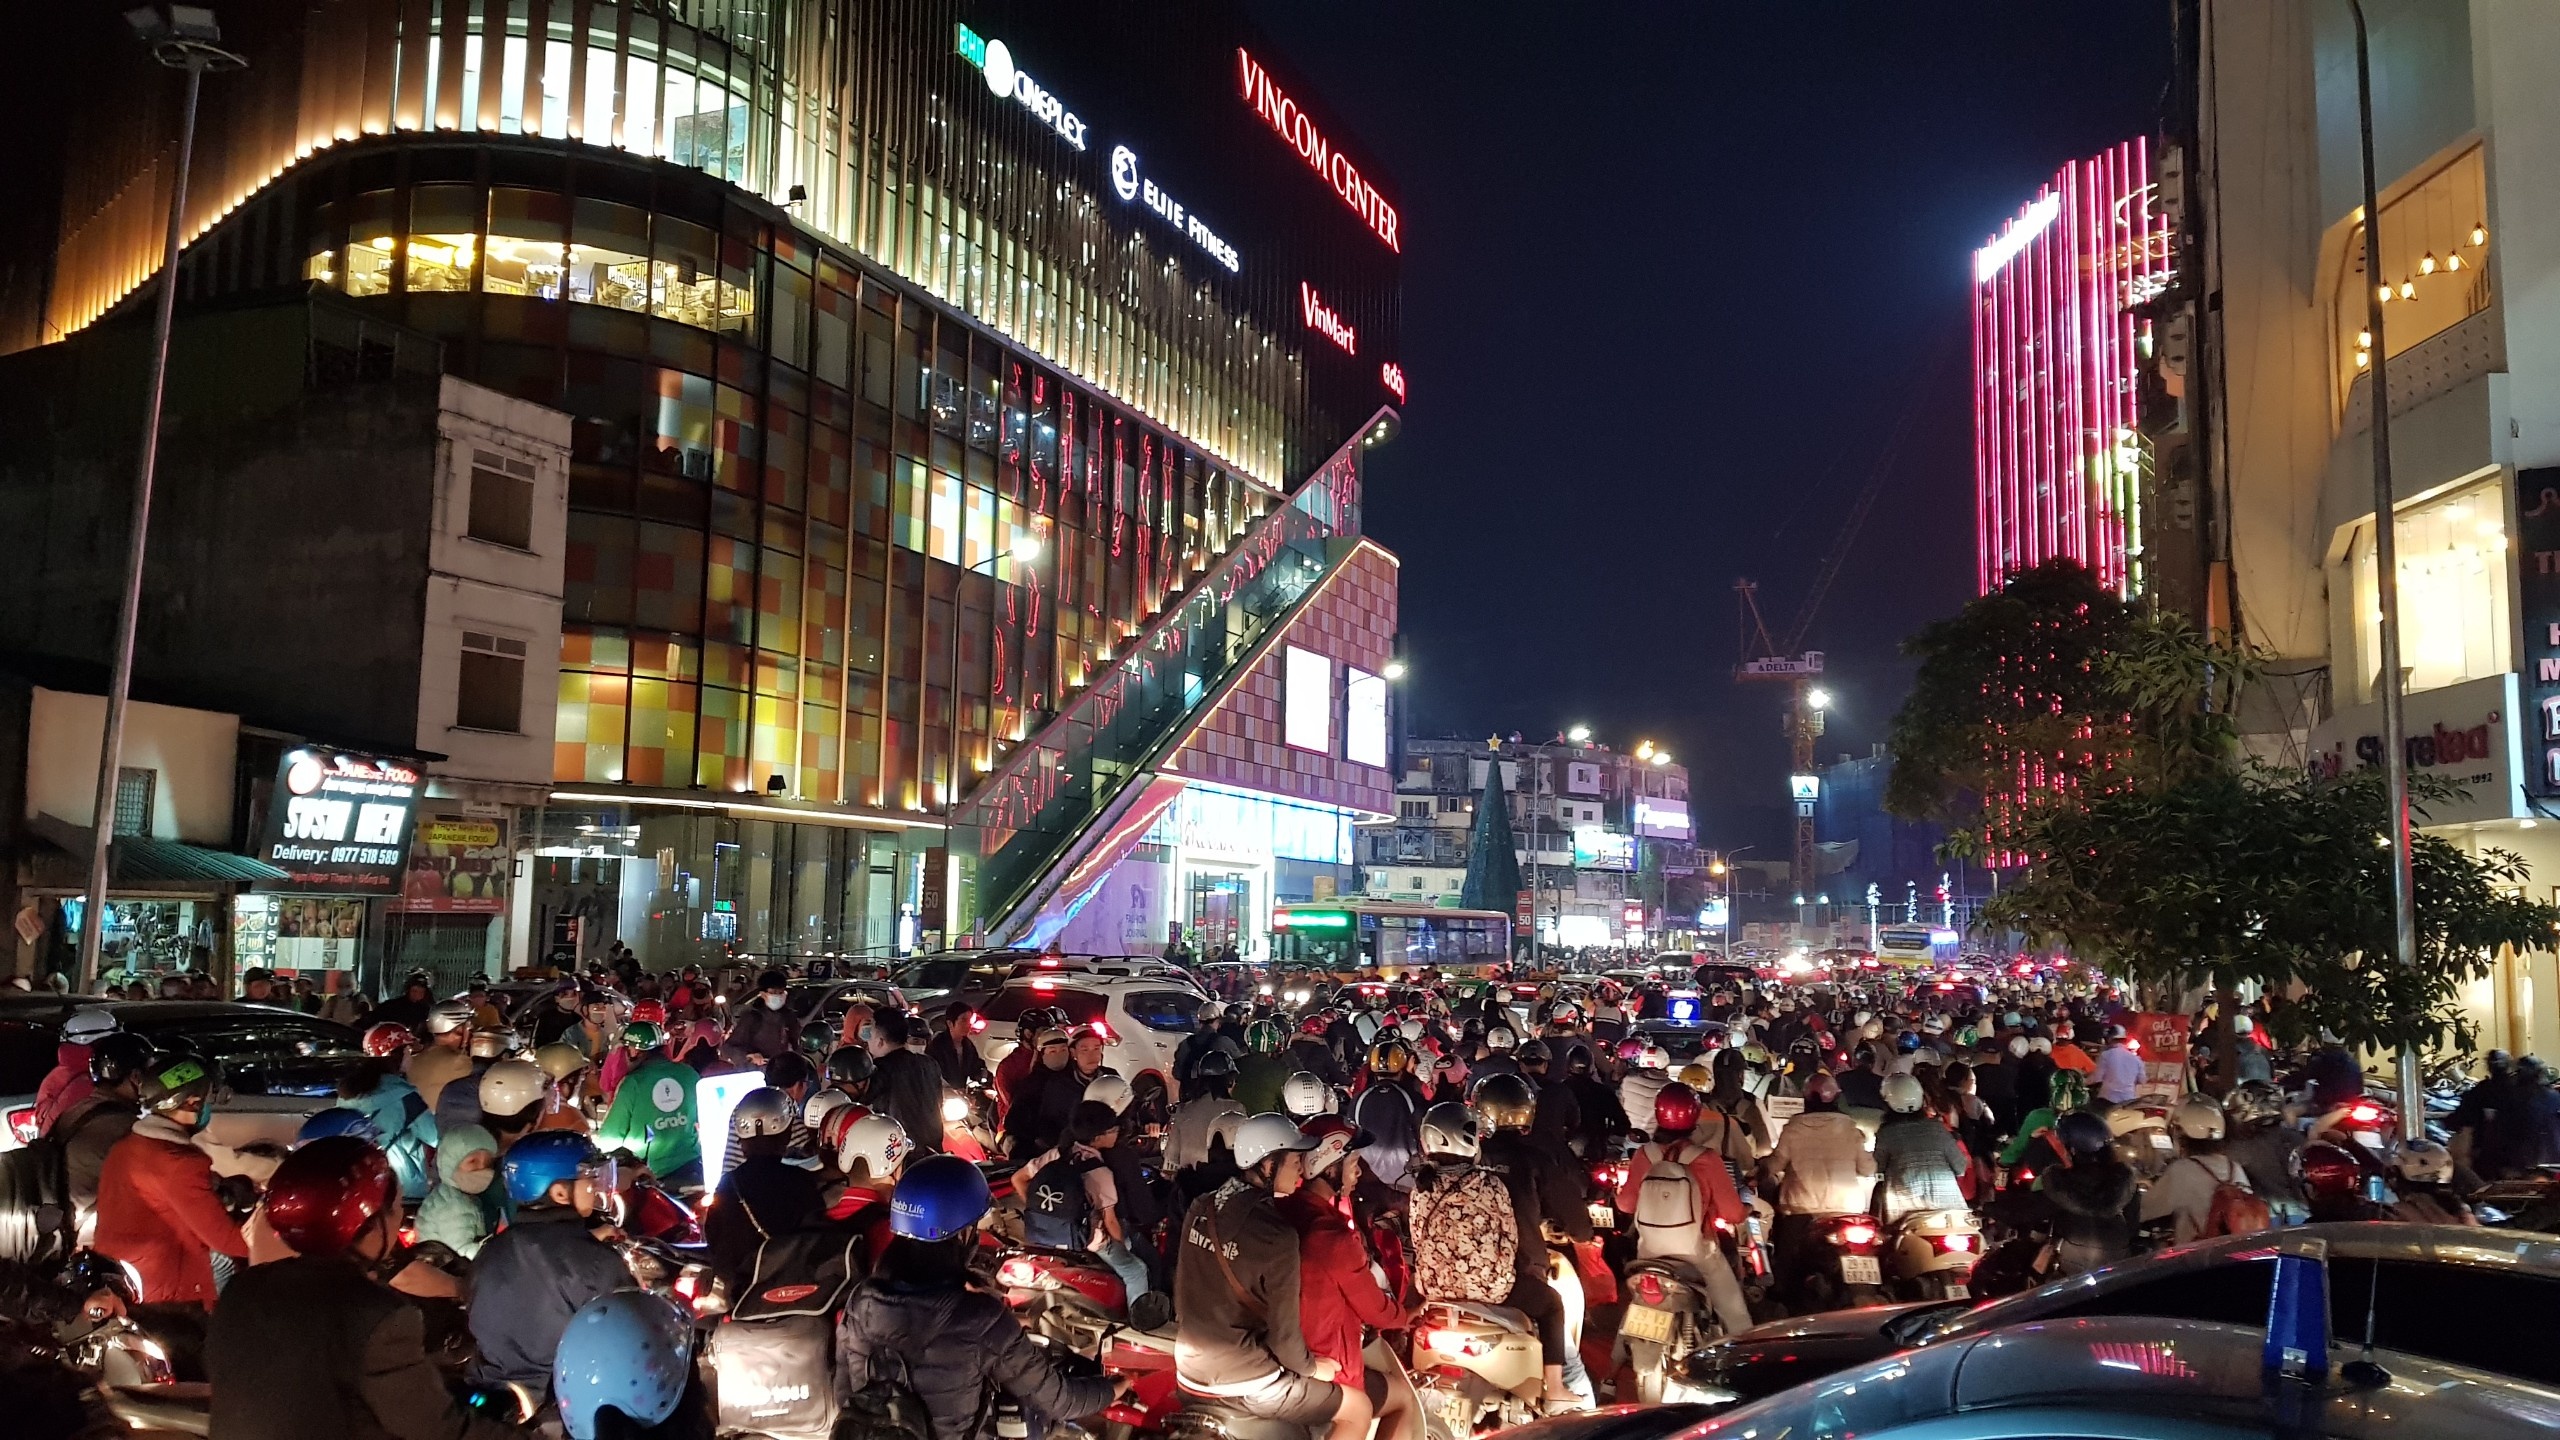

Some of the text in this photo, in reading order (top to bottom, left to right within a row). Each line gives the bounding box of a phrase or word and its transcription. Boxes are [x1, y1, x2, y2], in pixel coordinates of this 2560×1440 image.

[959, 22, 1086, 151] BHD CINEPLEX
[1237, 47, 1400, 254] VINCOM CENTER
[1144, 178, 1240, 273] ELITE FITNESS
[1302, 281, 1355, 355] VinMart
[1766, 663, 1796, 672] DELTA
[385, 768, 418, 784] FOOD
[272, 844, 399, 866] Delivery: 0977 518 589
[924, 891, 939, 909] 50
[1519, 915, 1531, 926] 50
[265, 901, 279, 968] SUSHI
[2152, 1017, 2172, 1031] GIÁ
[2153, 1028, 2182, 1048] TỐT
[654, 1111, 688, 1130] Grab
[908, 1203, 925, 1215] Life
